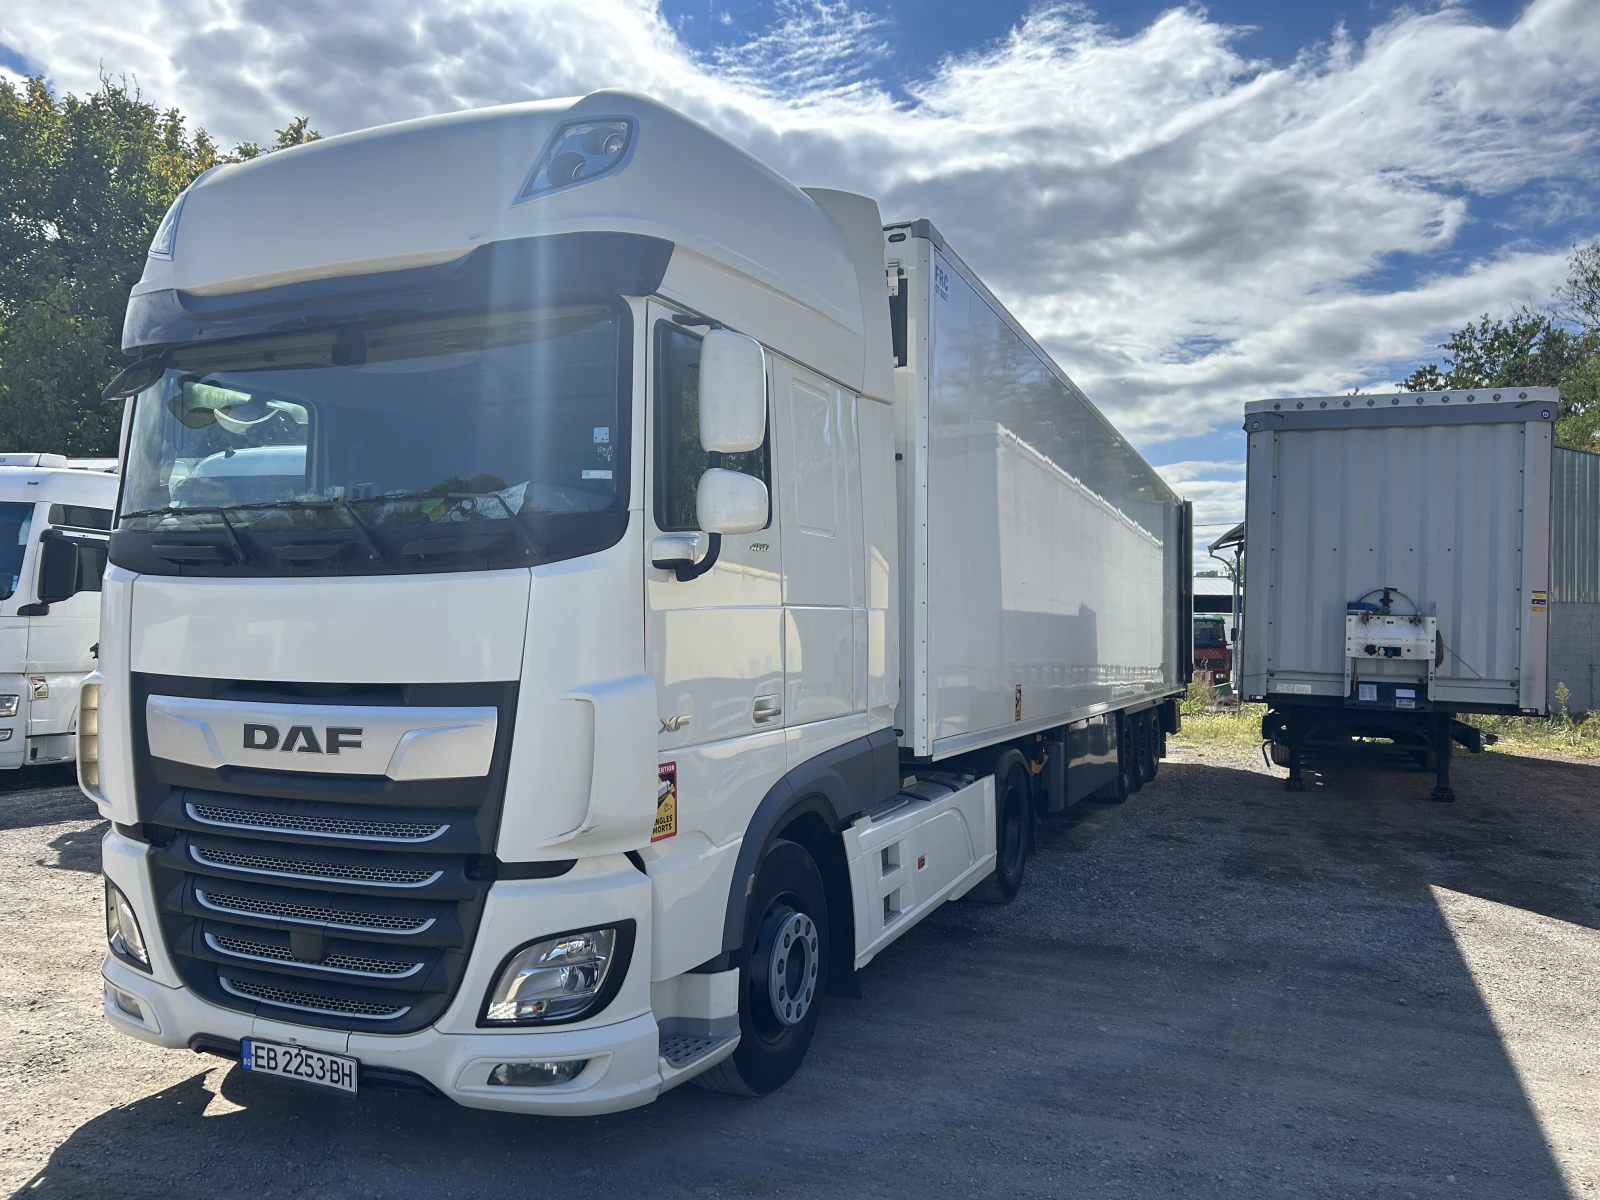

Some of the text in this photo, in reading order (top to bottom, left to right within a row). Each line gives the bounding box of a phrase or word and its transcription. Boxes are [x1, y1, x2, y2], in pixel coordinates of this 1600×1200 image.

[935, 264, 948, 292] FRC
[658, 714, 692, 734] XF
[243, 722, 363, 755] DAF
[652, 823, 672, 835] MORTS
[654, 814, 673, 826] NGLES
